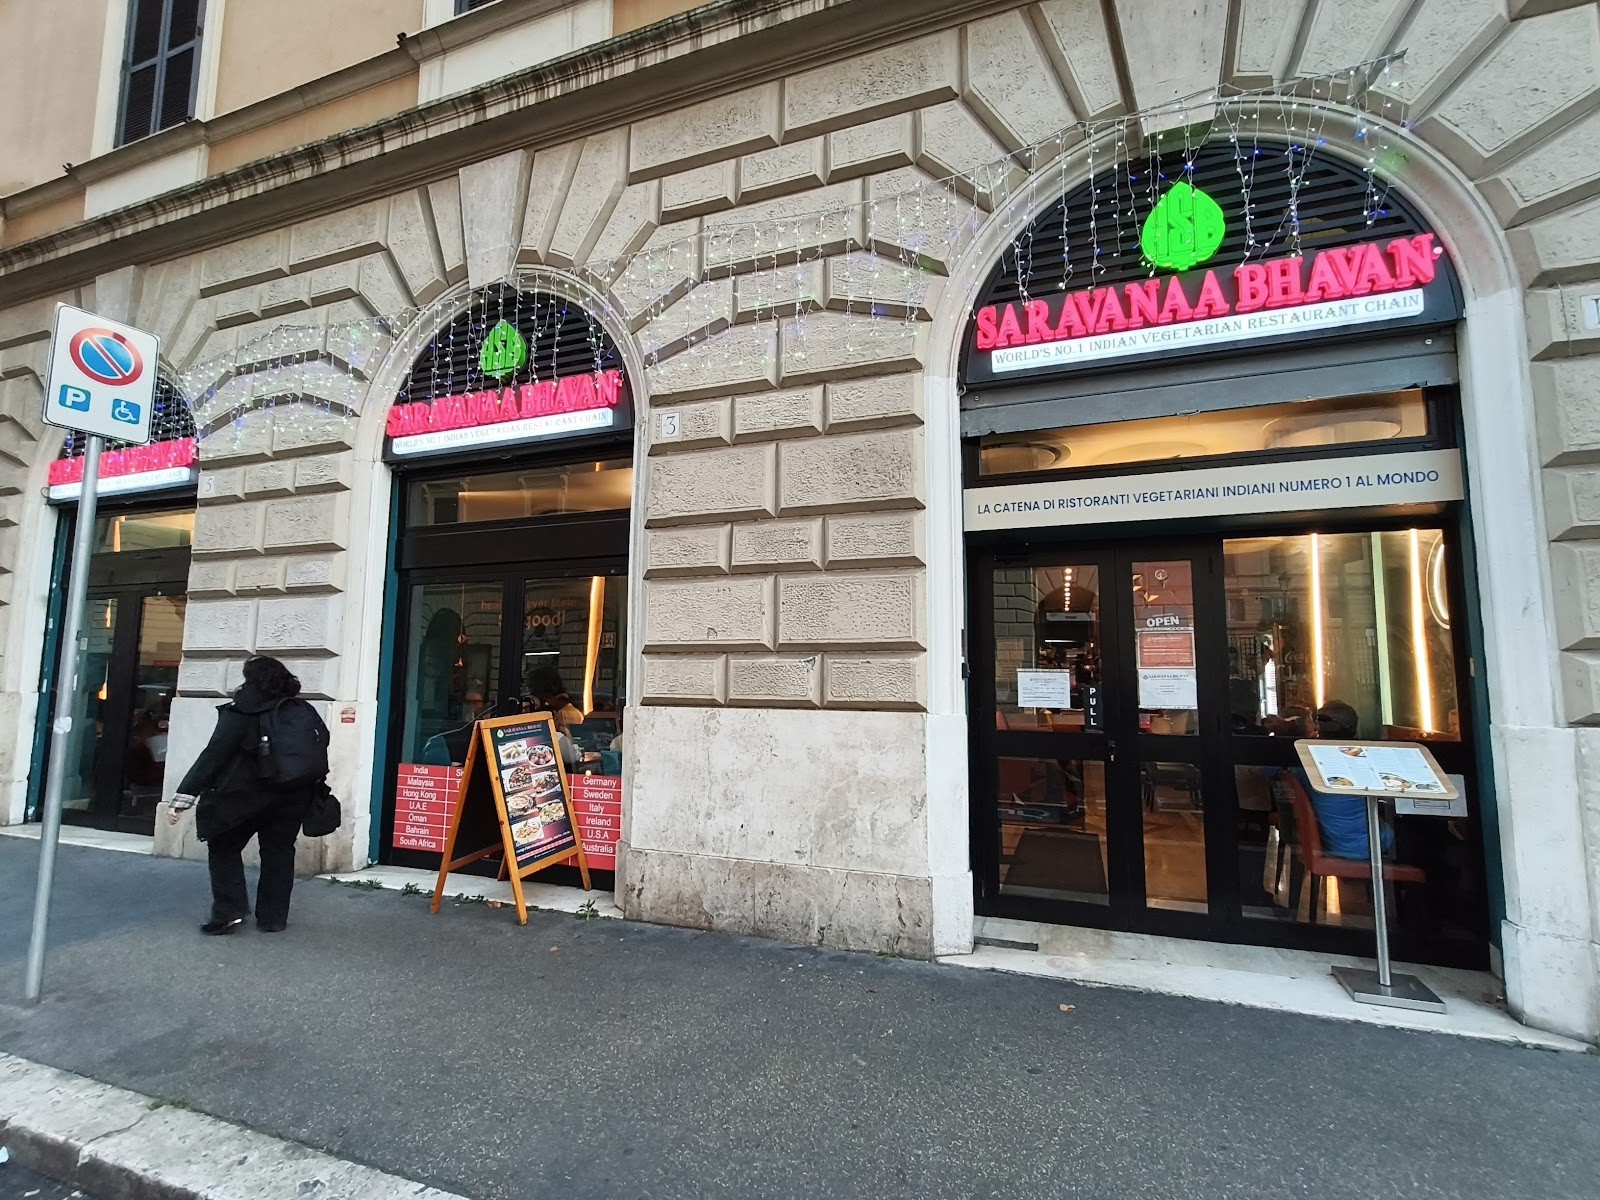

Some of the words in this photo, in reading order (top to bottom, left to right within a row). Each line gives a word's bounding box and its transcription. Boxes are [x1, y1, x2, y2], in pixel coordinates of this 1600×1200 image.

[976, 270, 1230, 350] SARAVANAA
[1235, 233, 1435, 312] BHAVAN
[995, 347, 1051, 364] WORLD'S
[1089, 335, 1137, 352] INDIAN
[1142, 320, 1242, 344] VEGETARIAN
[1247, 303, 1361, 329] RESTAURANT
[1364, 294, 1420, 313] CHAIN
[65, 387, 87, 406] P
[386, 387, 520, 437] SARAVANAA
[519, 370, 620, 418] BHAVAN
[443, 431, 469, 443] INDIAN
[579, 411, 607, 424] CHAIN
[665, 415, 676, 435] 3
[205, 477, 213, 492] 5
[977, 504, 991, 515] LA
[993, 500, 1041, 514] CATENA
[1043, 499, 1055, 511] DI
[1058, 494, 1130, 510] RISTORANTI
[1133, 487, 1219, 504] VEGETARIANI
[1223, 482, 1276, 496] INDIANI
[1279, 477, 1342, 493] NUMERO
[1345, 476, 1351, 488] 1
[1355, 475, 1373, 488] AL
[1377, 470, 1439, 487] MONDO
[1146, 615, 1180, 628] OPEN
[1089, 687, 1097, 726] PULL
[413, 765, 429, 775] India
[406, 777, 434, 788] Malaysia
[582, 776, 617, 789] Germany
[402, 788, 419, 800] Hong
[420, 790, 437, 801] Kong
[583, 789, 614, 800] Sweden
[409, 801, 428, 811] U.A.E
[588, 802, 605, 815] Italy
[408, 813, 428, 823] Oman
[585, 816, 612, 827] Ireland
[405, 824, 430, 835] Bahrain
[587, 829, 609, 840] U.S.A
[399, 836, 418, 847] South
[417, 838, 436, 849] Africa
[581, 842, 614, 854] Australia
